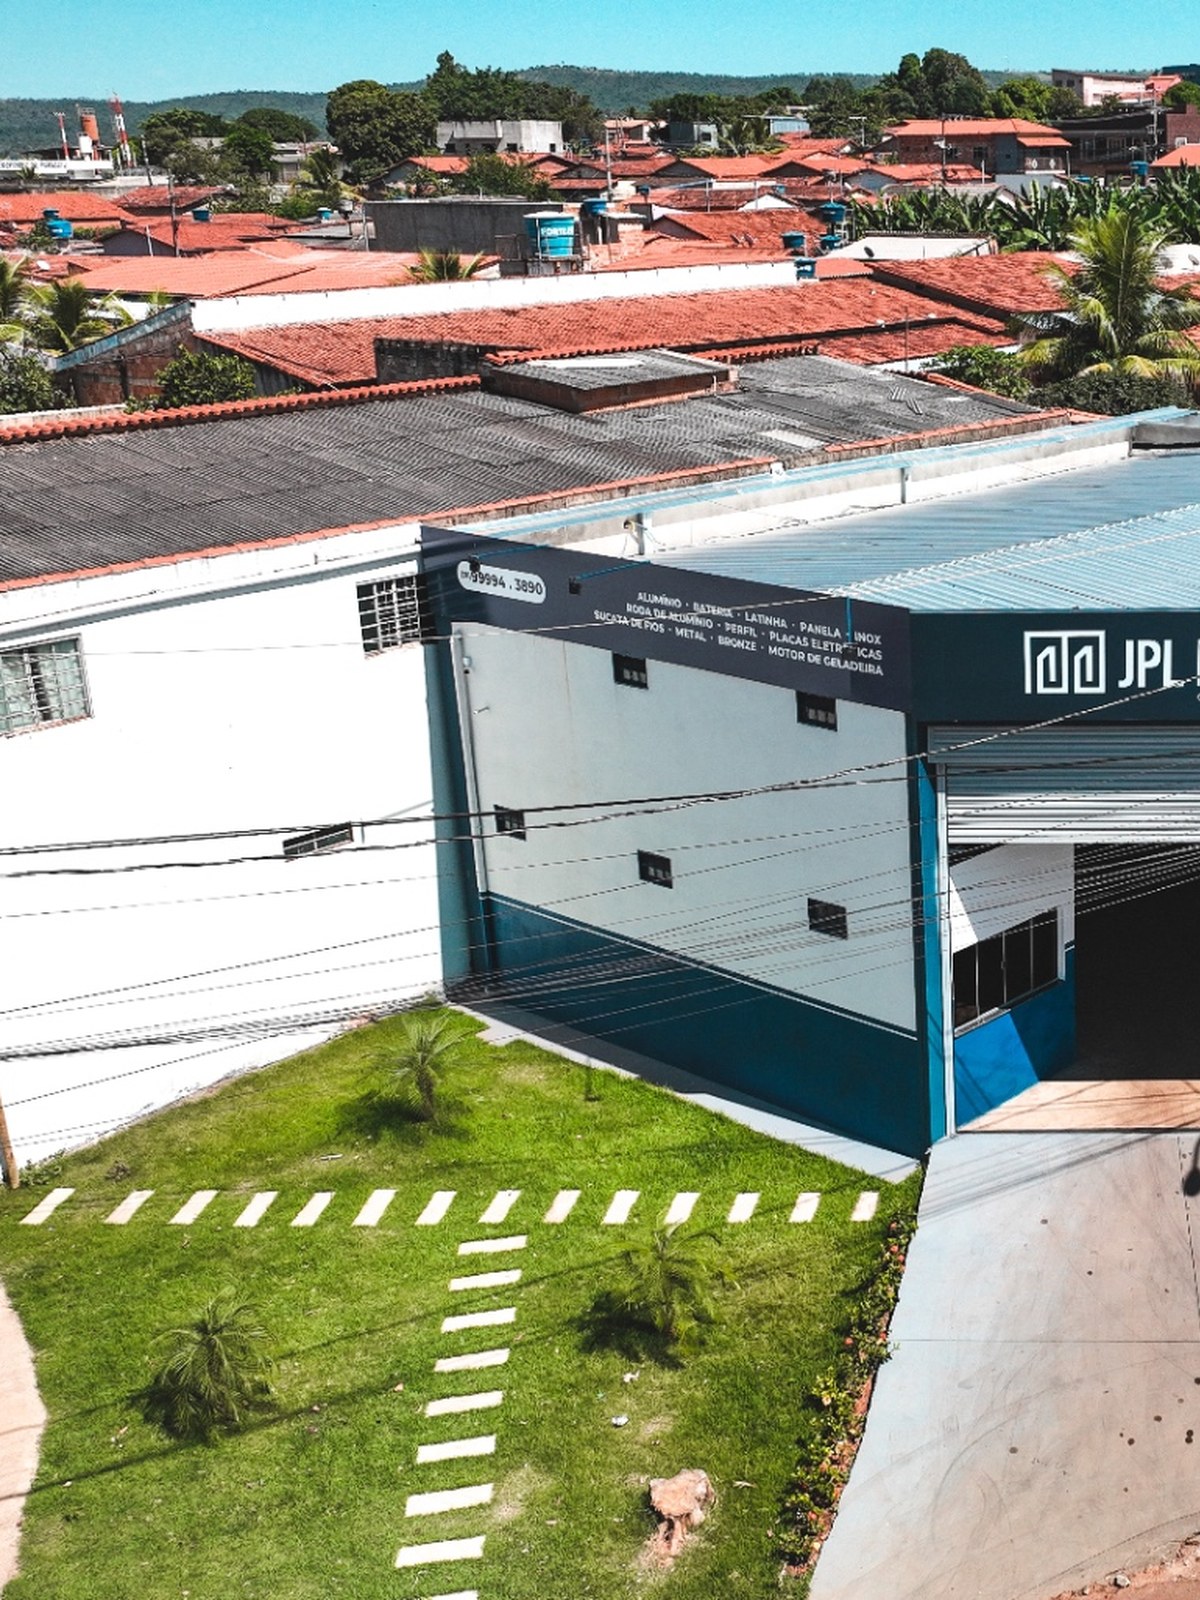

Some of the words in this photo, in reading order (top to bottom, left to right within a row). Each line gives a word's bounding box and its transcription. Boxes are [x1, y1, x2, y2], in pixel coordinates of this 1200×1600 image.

[593, 609, 630, 626] SUCATA
[630, 617, 643, 629] DE
[644, 620, 665, 634] FIOS
[675, 626, 707, 643] METAL
[718, 635, 757, 652] BRONZE
[768, 645, 806, 662] MOTOR
[806, 652, 822, 665] DE
[823, 655, 884, 676] GELADEIRA
[626, 602, 652, 617] RODA
[725, 621, 758, 638] PERFIL
[769, 630, 809, 647] PLACAS
[637, 591, 682, 608] ALUMÍNIO
[744, 611, 789, 629] LATINHA
[800, 621, 842, 639] PANELA
[854, 631, 882, 645] INOX
[1118, 639, 1186, 688] JPL
